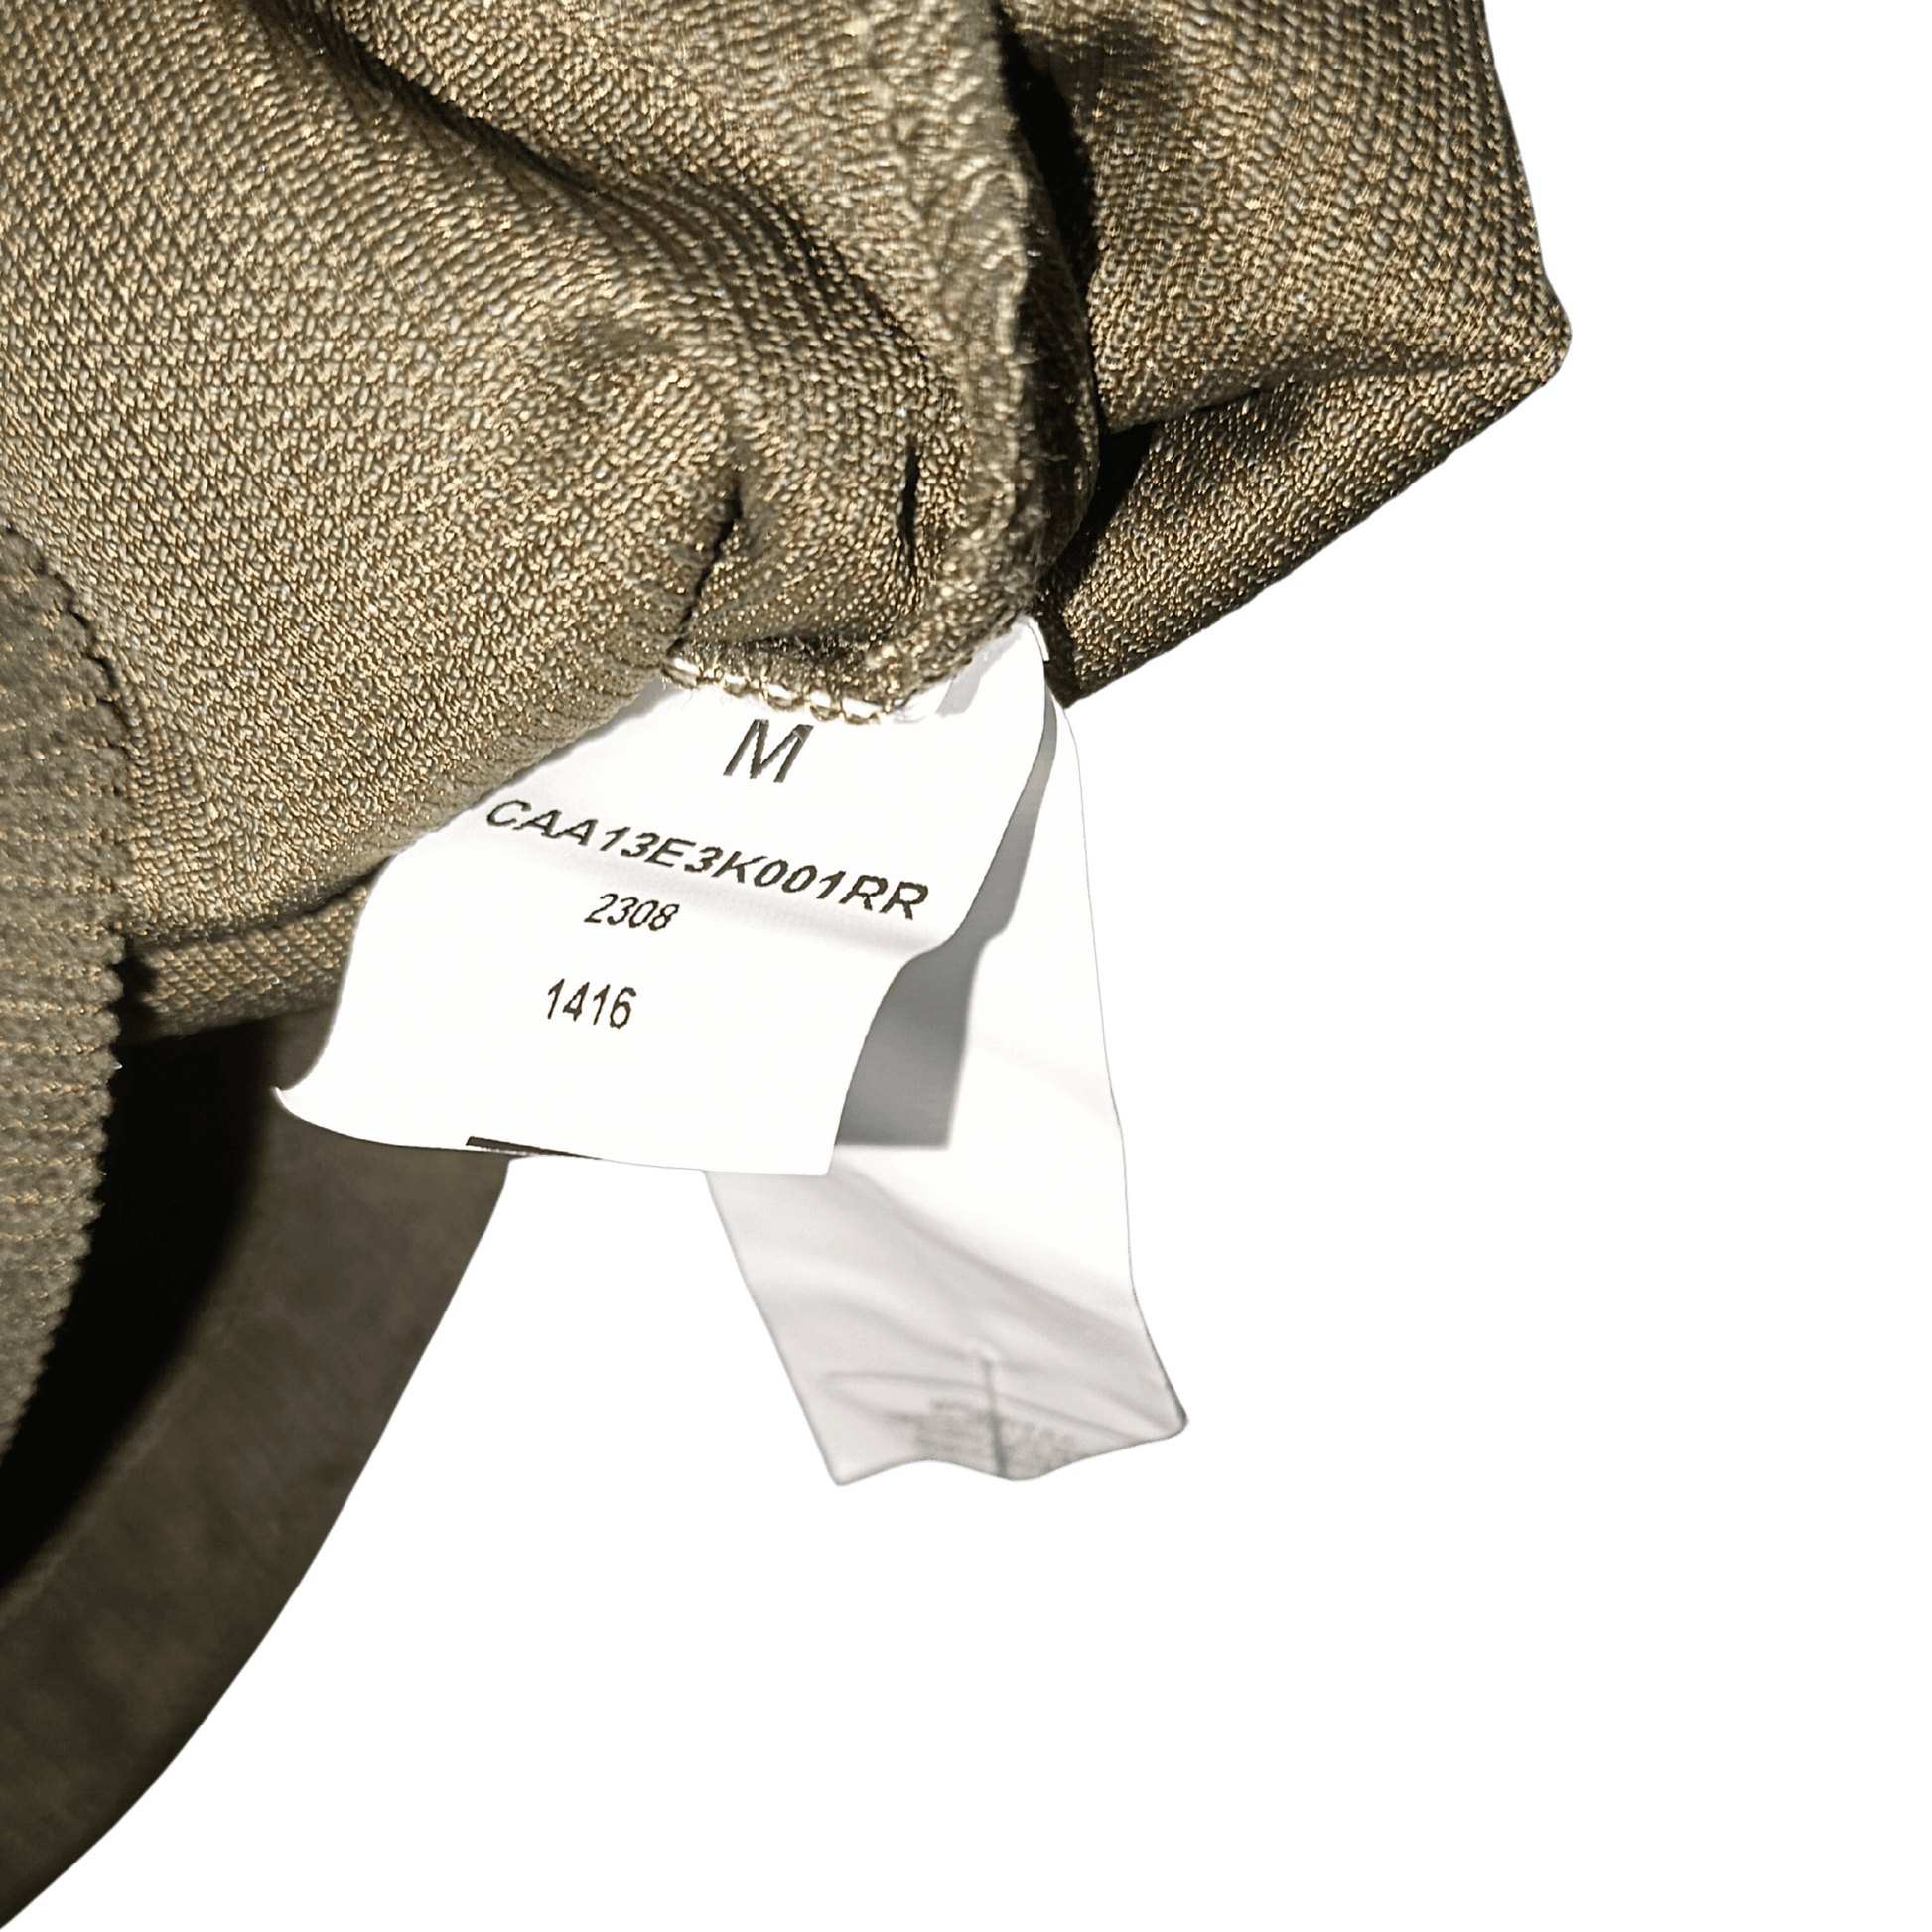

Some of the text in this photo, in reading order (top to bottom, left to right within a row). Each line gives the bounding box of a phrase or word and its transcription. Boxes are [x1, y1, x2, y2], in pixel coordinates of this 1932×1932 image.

[724, 719, 814, 783] M
[486, 800, 929, 919] CAA13E3K001RR
[584, 893, 680, 931] 2308
[547, 978, 637, 1029] 1416
